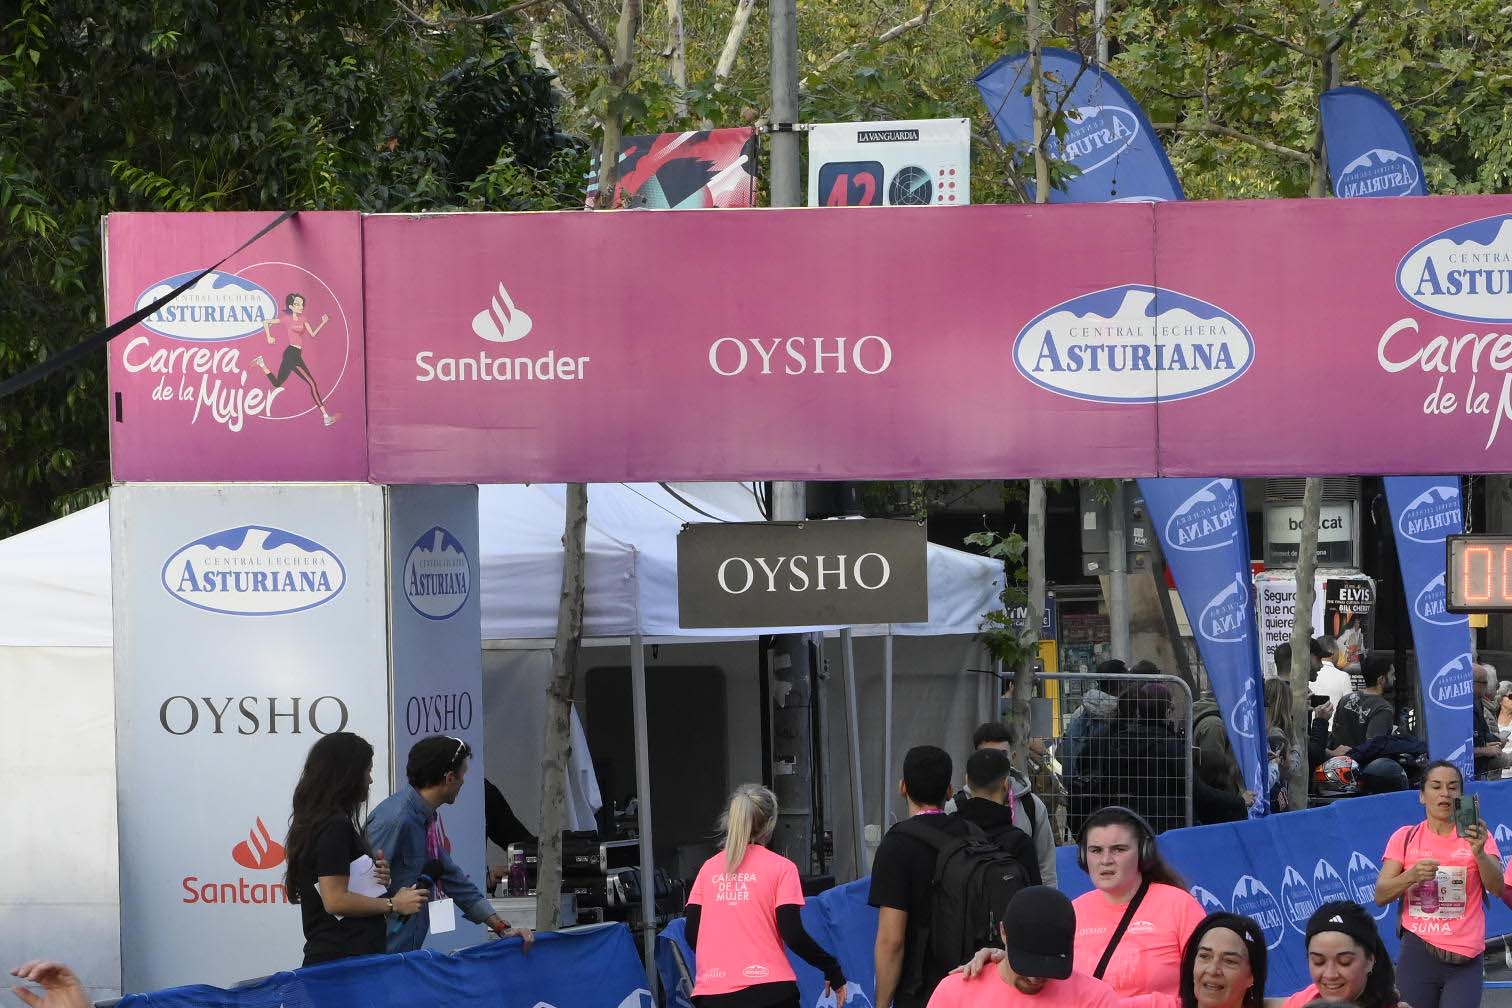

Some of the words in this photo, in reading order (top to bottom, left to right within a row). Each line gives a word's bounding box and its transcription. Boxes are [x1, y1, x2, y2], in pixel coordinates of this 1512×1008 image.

[871, 131, 919, 142] VANGUARDIA
[147, 297, 267, 323] ASTURIANA
[1069, 326, 1144, 338] CENTRAL
[1151, 325, 1229, 337] LECHERA
[123, 336, 240, 374] Carrera
[708, 335, 893, 376] OYSHO
[1031, 329, 1237, 373] ASTURIANA
[415, 350, 591, 382] Santander
[152, 376, 173, 401] de
[178, 376, 194, 401] la
[192, 371, 285, 432] Mujer
[1423, 376, 1457, 415] de
[1466, 374, 1490, 414] la
[1289, 516, 1343, 531] b.cat
[204, 557, 262, 567] CENTRAL
[267, 557, 326, 567] LECHERA
[718, 552, 891, 594] OYSHO
[176, 559, 333, 593] ASTURIANA
[408, 560, 467, 597] ASTURIANA
[1339, 588, 1370, 601] ELVIS
[1265, 606, 1280, 616] que
[159, 695, 349, 735] OYSHO
[406, 691, 472, 736] OYSHO
[712, 873, 757, 885] CARRERA
[719, 882, 731, 892] DE
[735, 881, 747, 892] LA
[716, 891, 749, 902] MUJER
[1411, 922, 1451, 933] SUMA
